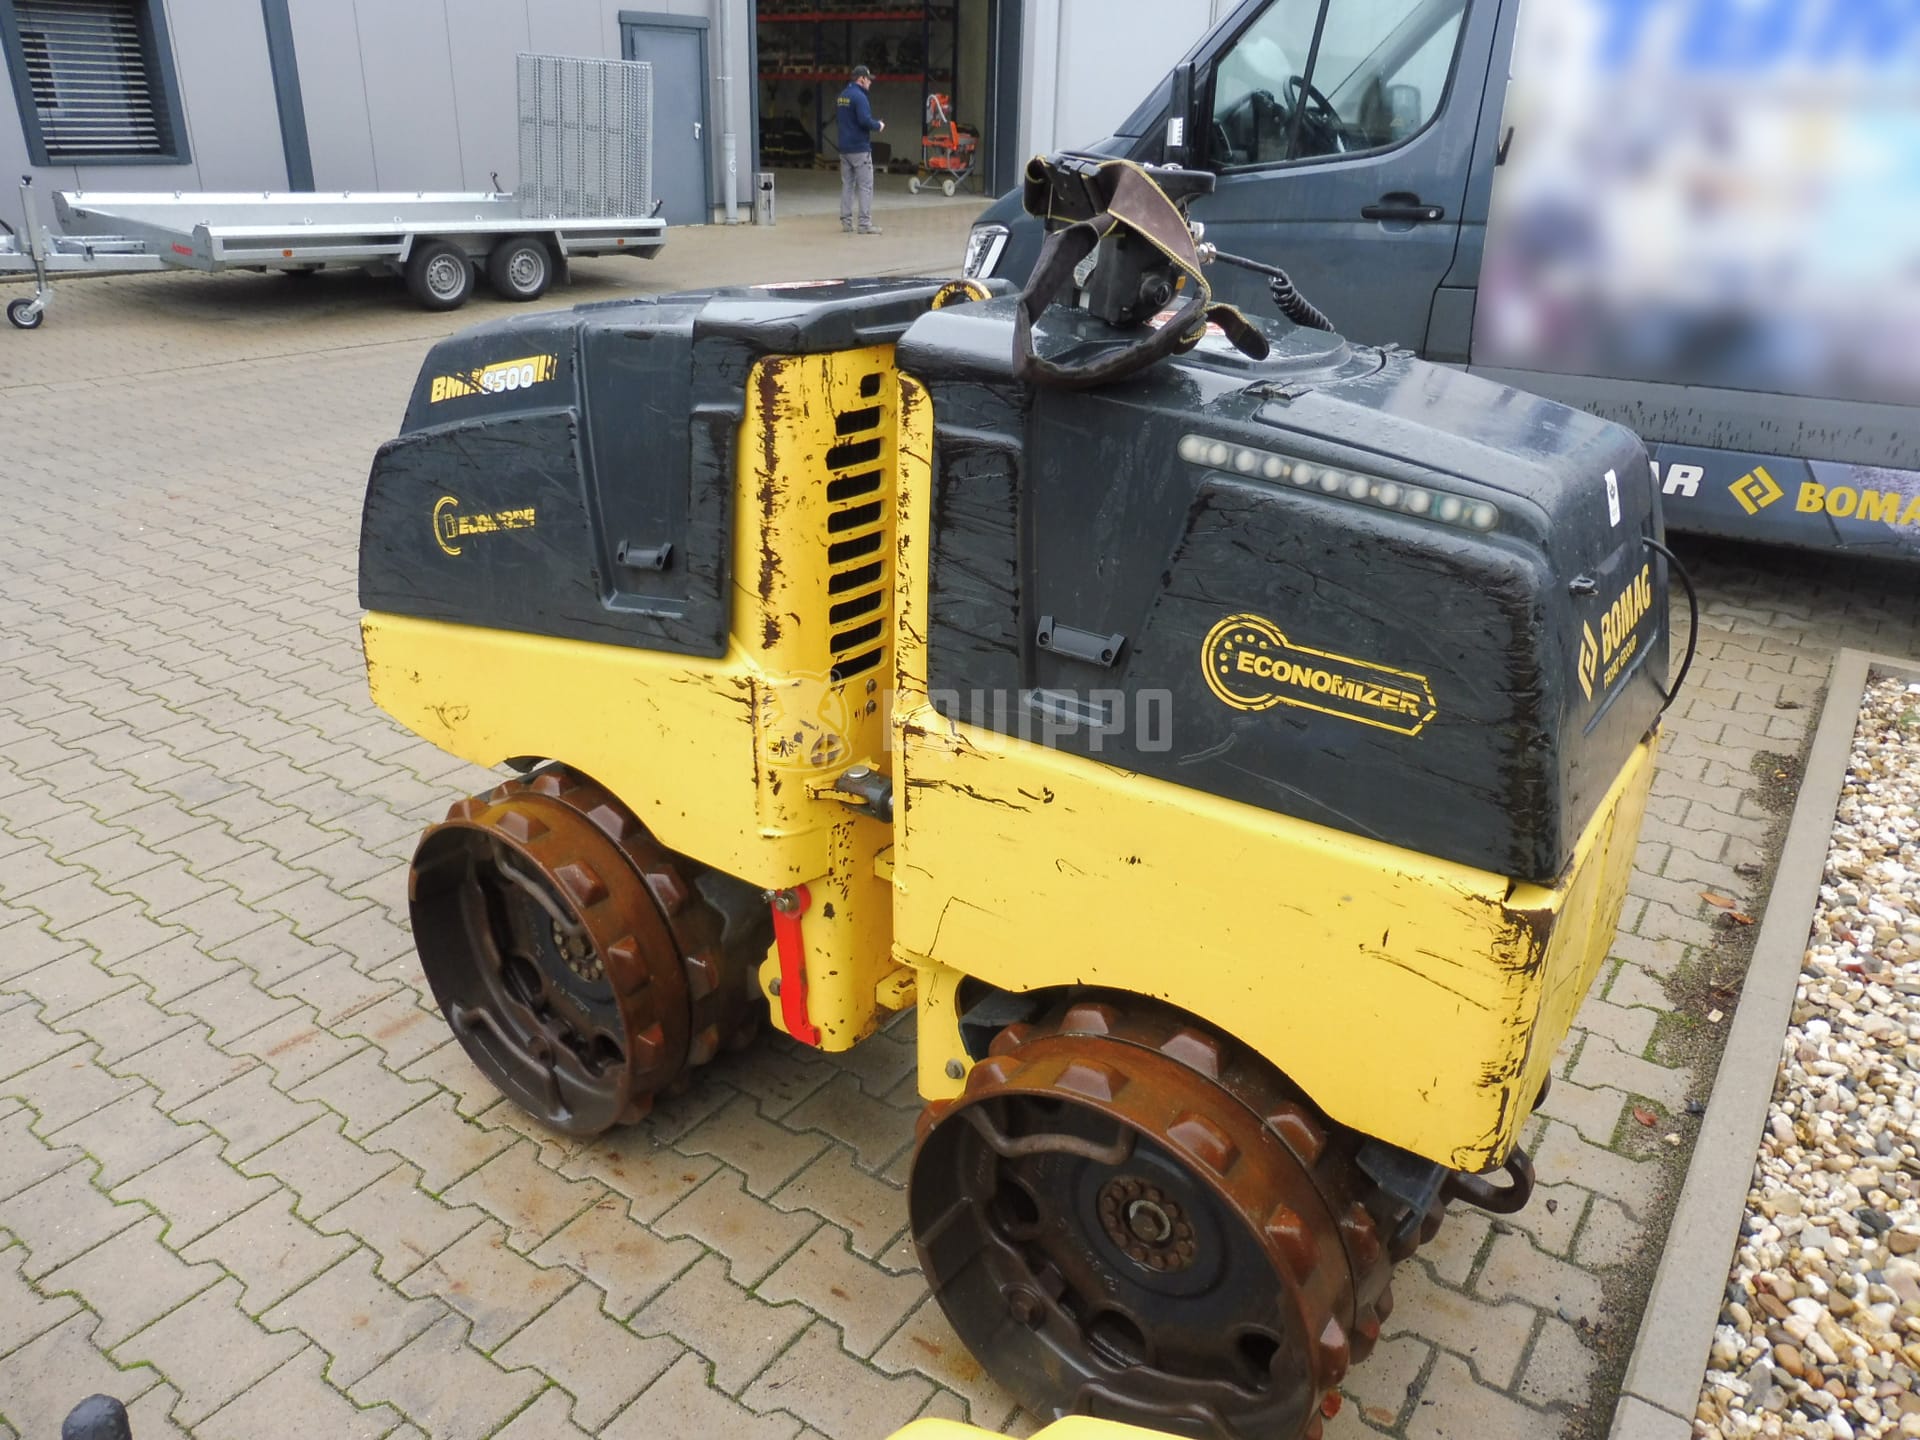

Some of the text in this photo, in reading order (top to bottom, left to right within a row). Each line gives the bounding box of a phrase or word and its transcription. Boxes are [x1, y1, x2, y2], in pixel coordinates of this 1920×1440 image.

[481, 364, 534, 395] 8500
[1601, 563, 1651, 665] BOMAG
[1236, 651, 1421, 717] ECONOMIZER
